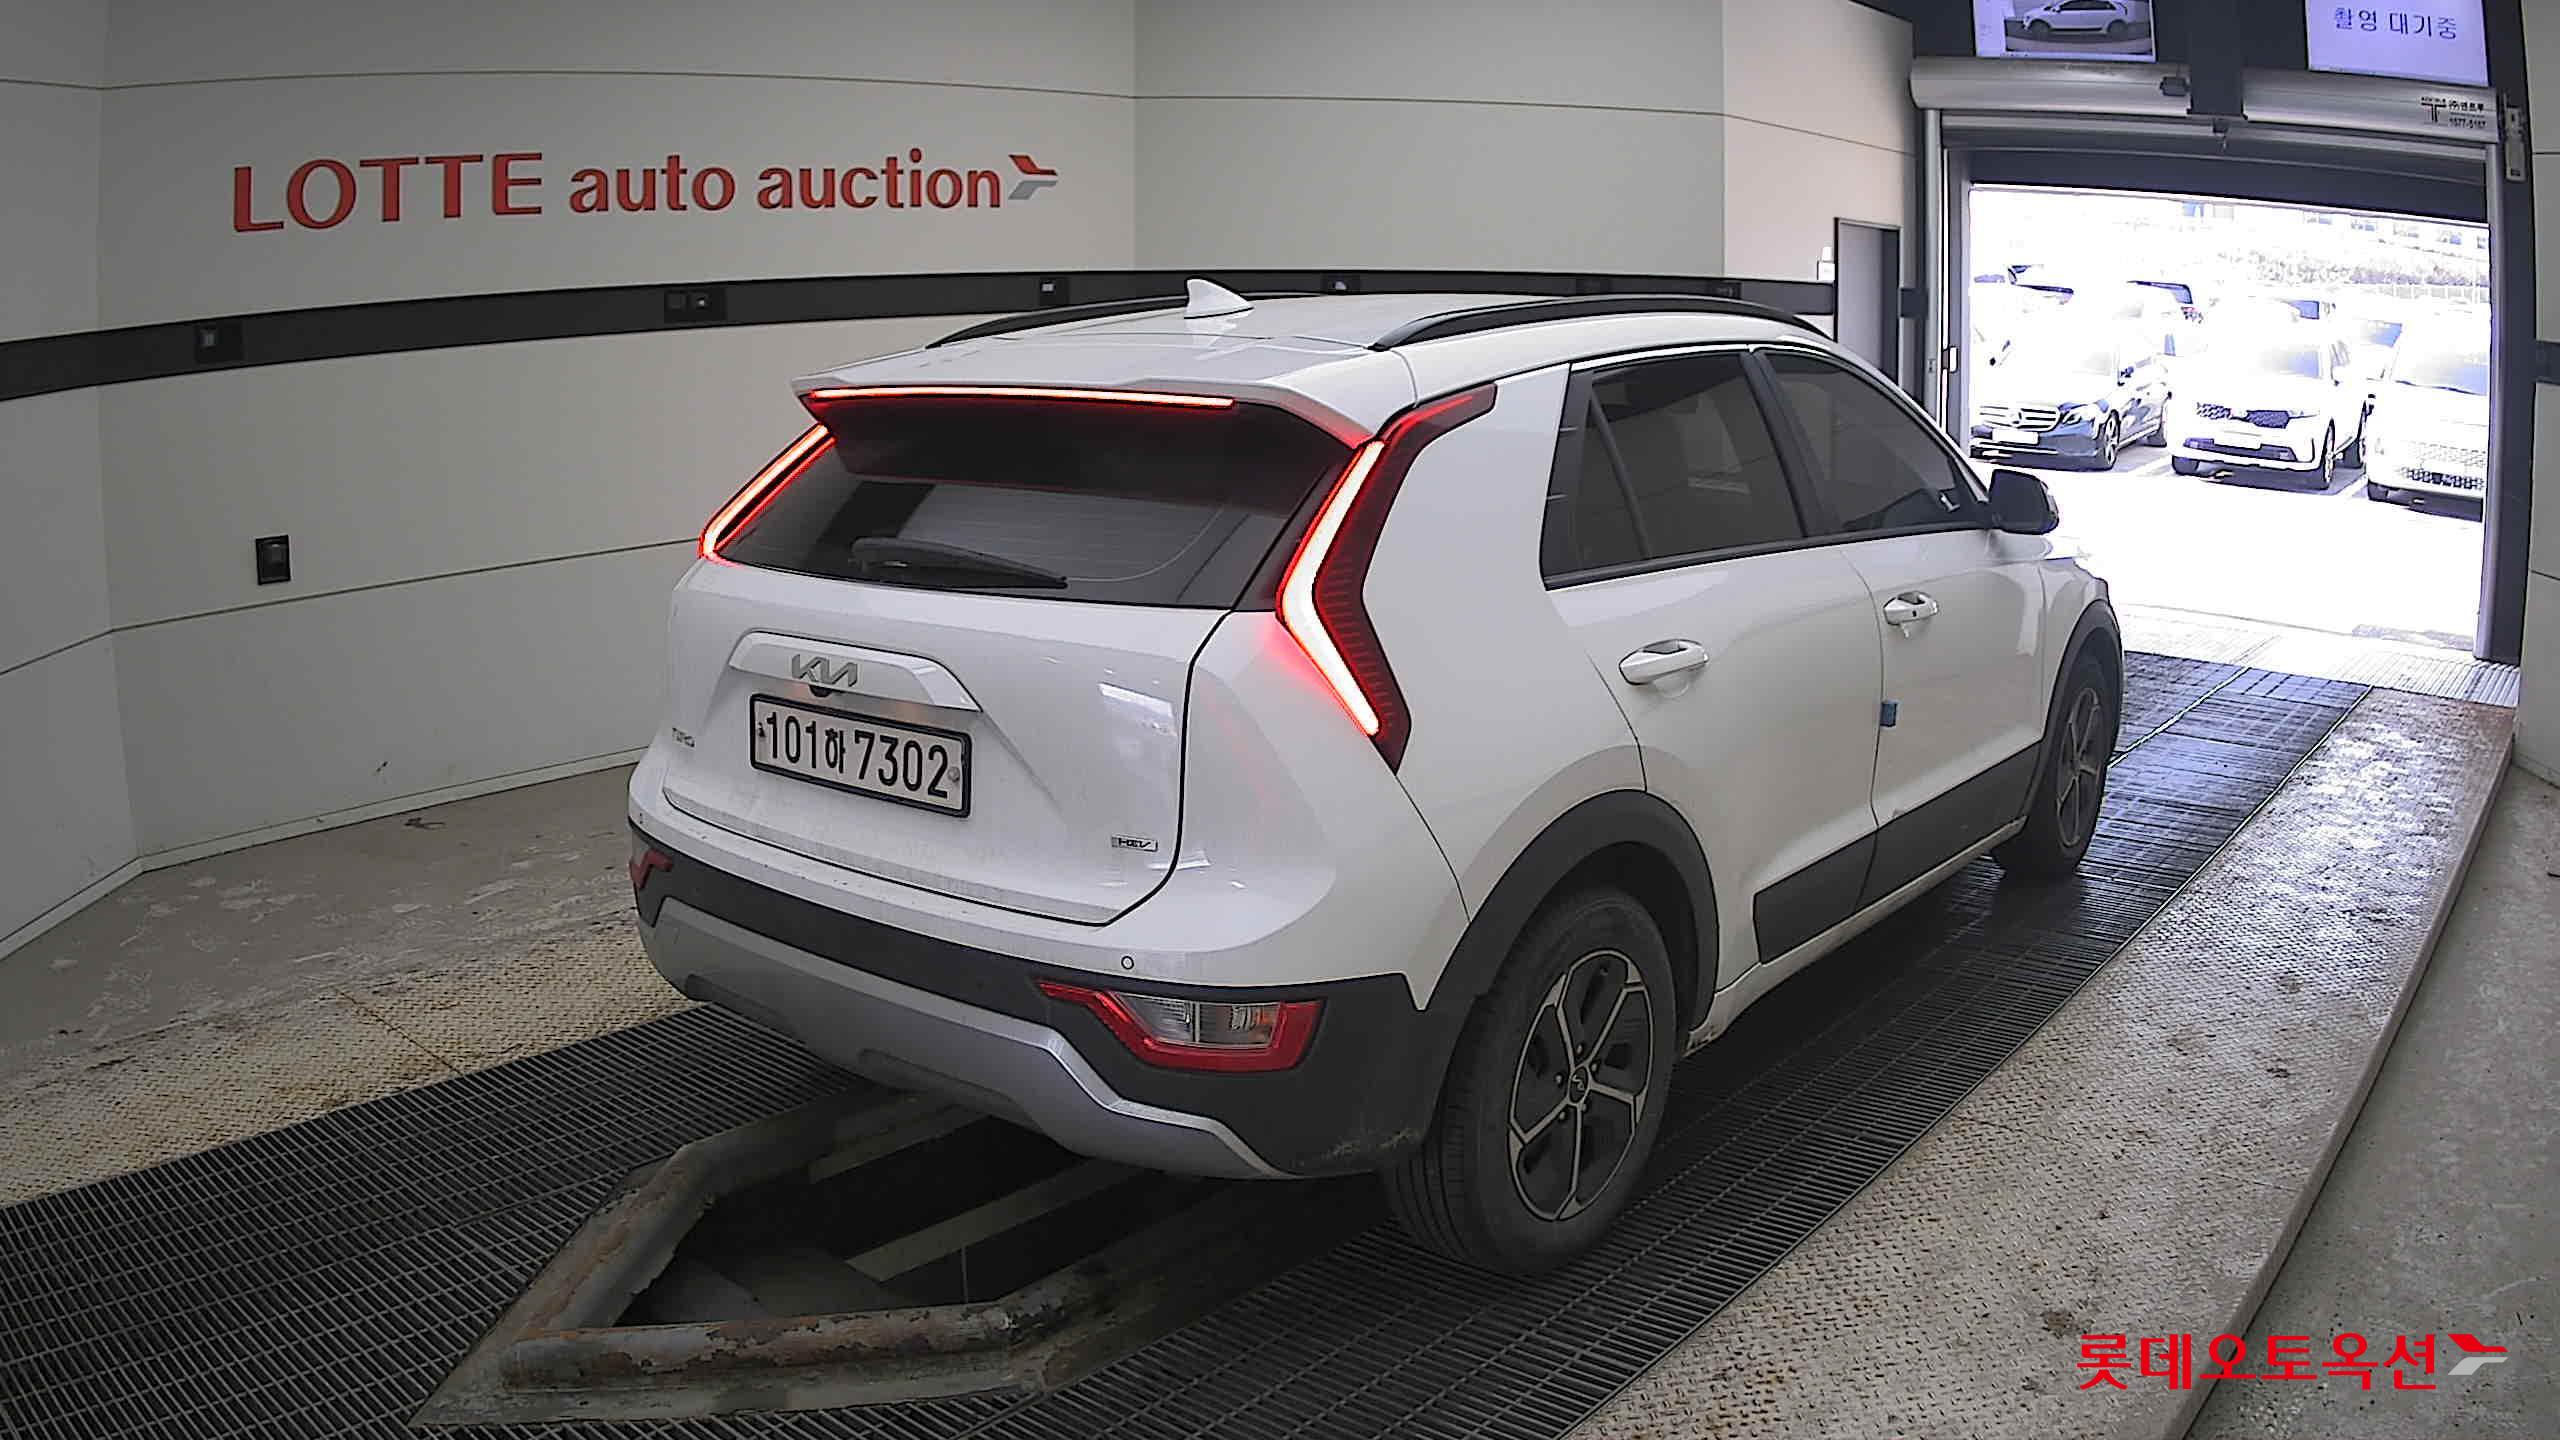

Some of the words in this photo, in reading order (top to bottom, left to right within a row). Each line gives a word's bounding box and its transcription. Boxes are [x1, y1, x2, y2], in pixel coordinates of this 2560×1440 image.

[2335, 7, 2377, 32] 촬영
[2389, 12, 2457, 40] 대기중
[233, 152, 543, 233] LOTTE
[568, 154, 736, 213] auto
[757, 148, 1001, 210] auction
